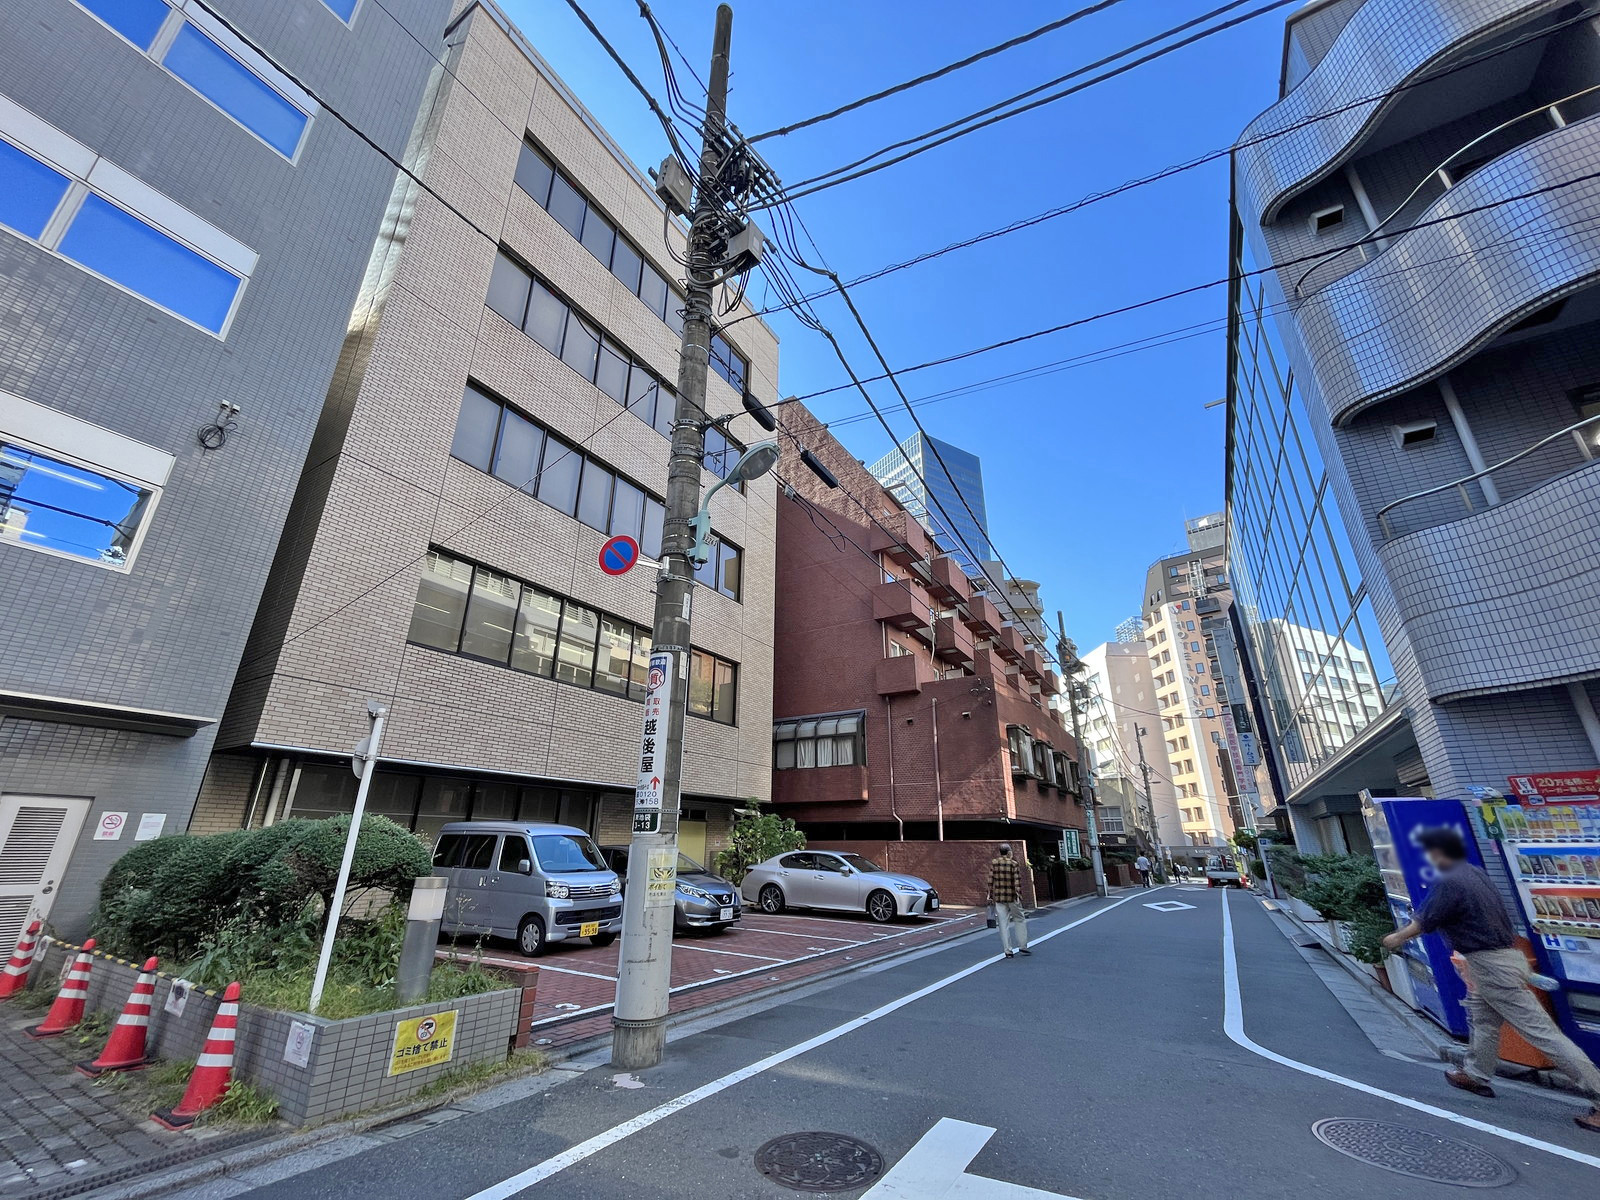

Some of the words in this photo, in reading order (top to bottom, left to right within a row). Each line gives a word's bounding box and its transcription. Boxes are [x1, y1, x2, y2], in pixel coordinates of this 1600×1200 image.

[641, 718, 657, 773] 越後屋
[396, 1037, 448, 1058] ゴミ捨て禁止
